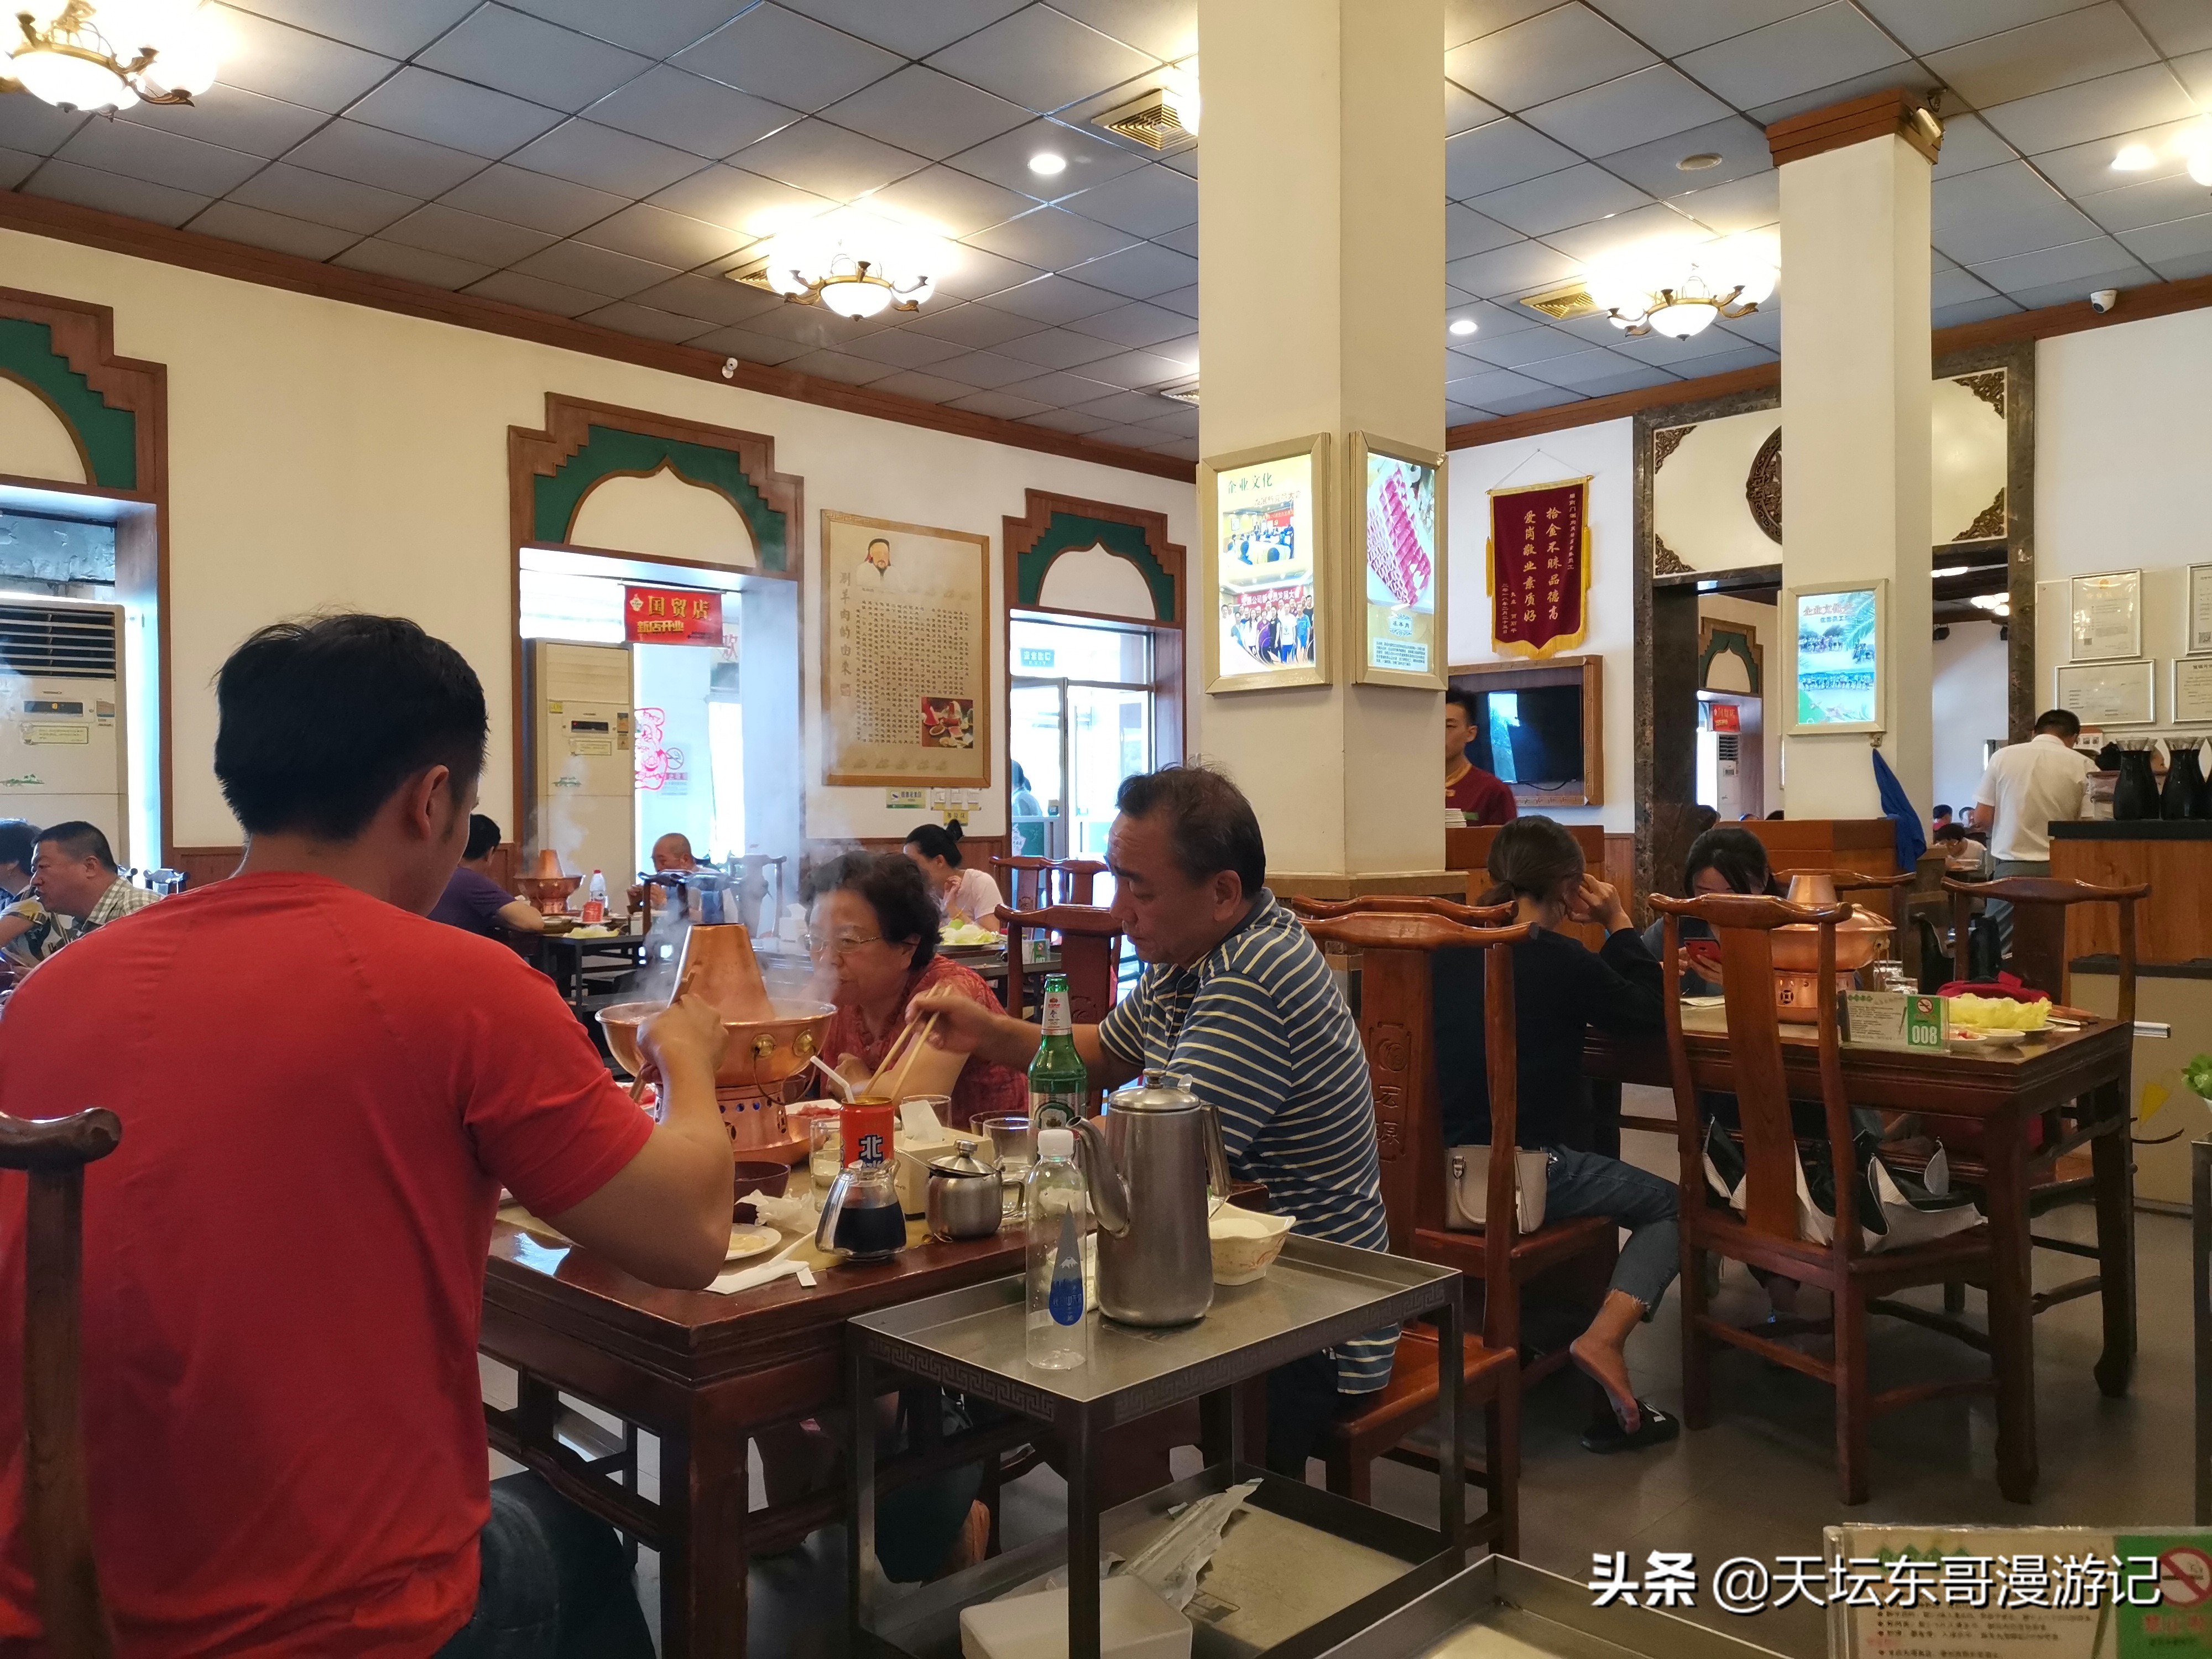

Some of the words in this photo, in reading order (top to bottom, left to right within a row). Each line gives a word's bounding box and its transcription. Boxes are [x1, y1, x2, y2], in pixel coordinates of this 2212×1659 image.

[1228, 472, 1272, 494] 企业文化
[1523, 510, 1537, 622] 爱岗敬业素质好
[1546, 507, 1562, 620] 拾金不昧品德高
[648, 596, 709, 619] 国贸店
[637, 620, 685, 633] 新店开业
[1024, 650, 1051, 661] 安全出口
[1912, 1025, 1938, 1044] 008
